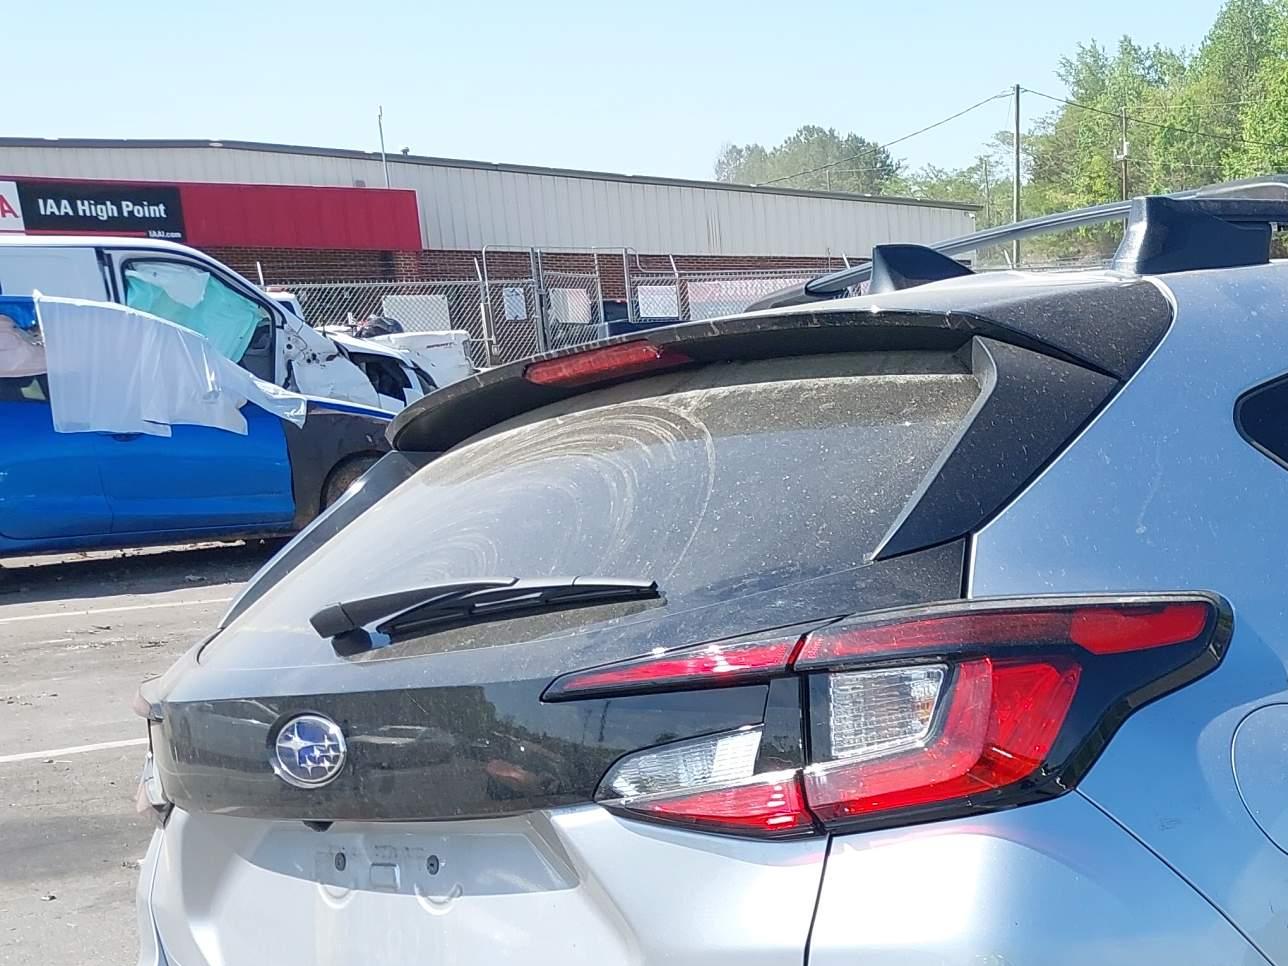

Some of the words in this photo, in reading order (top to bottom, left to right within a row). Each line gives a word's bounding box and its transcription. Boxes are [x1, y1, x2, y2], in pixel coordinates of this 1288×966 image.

[38, 198, 74, 216] IAA
[76, 200, 118, 220] High
[121, 201, 168, 218] Point
